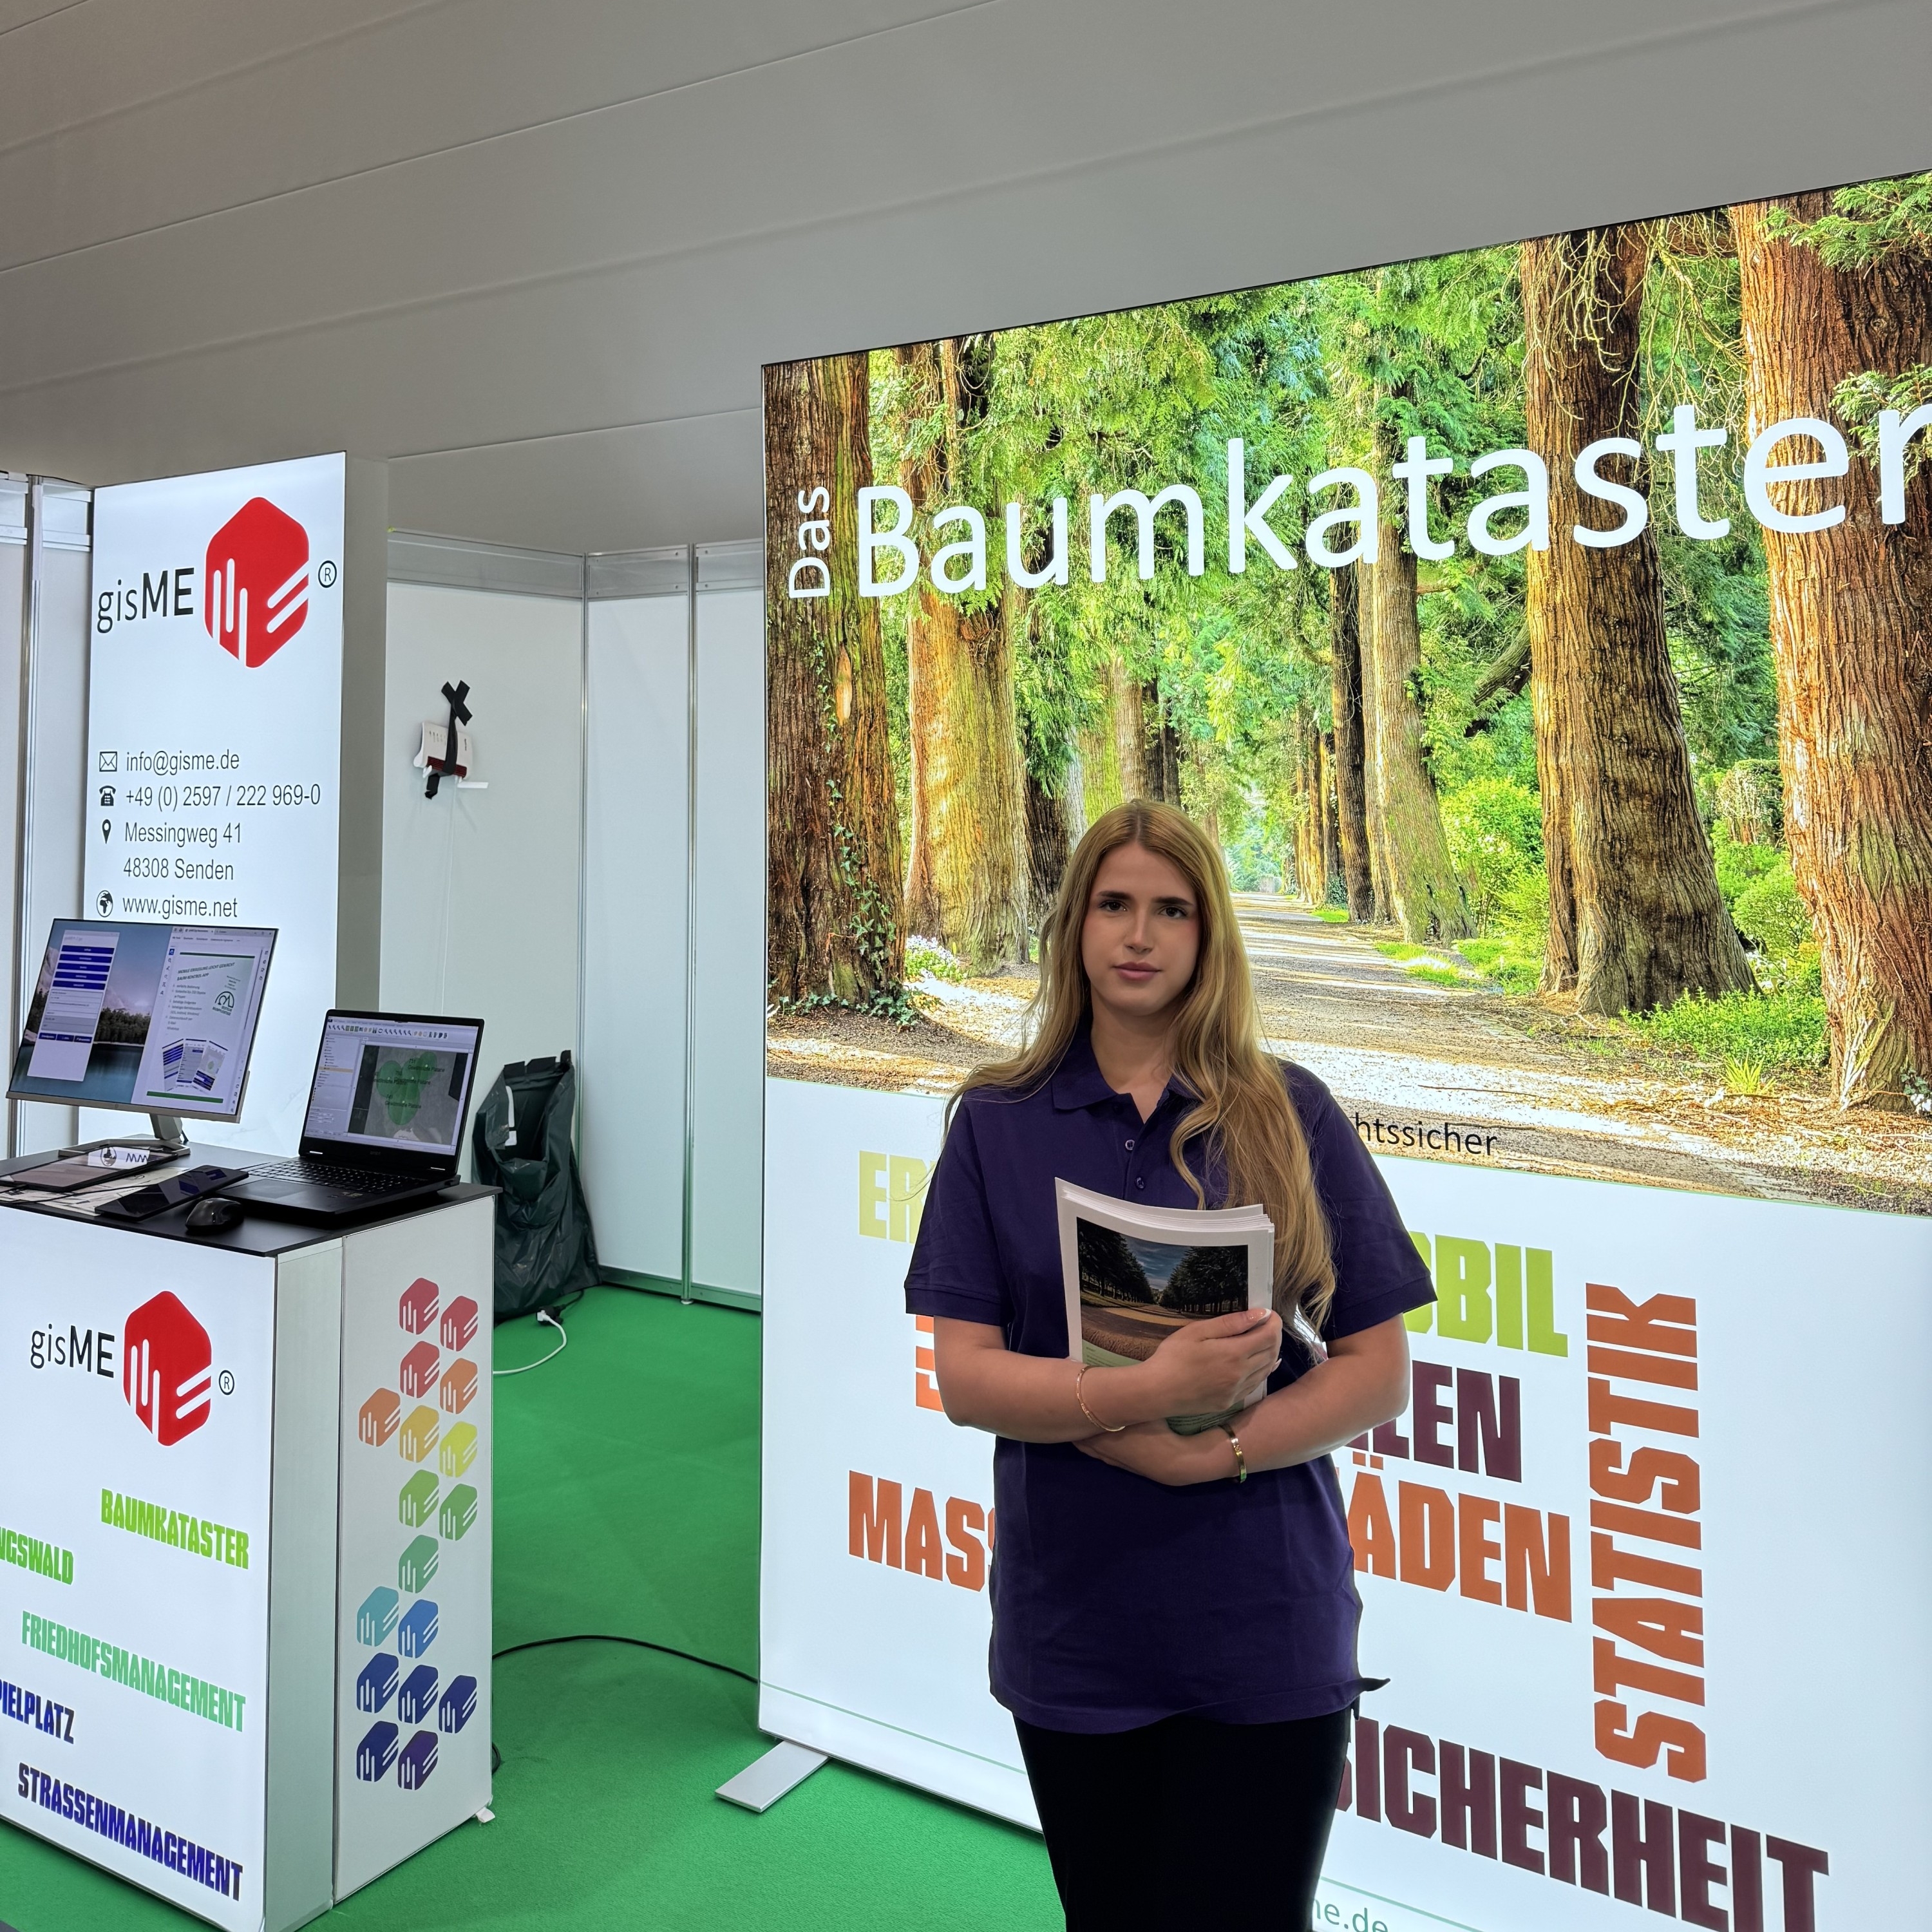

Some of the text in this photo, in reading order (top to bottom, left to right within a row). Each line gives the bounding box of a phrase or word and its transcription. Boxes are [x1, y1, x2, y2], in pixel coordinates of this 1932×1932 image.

[858, 403, 1932, 598] Baumkataster
[789, 486, 830, 598] Das
[97, 567, 194, 634] gisME
[126, 748, 240, 776] info@gisme.de
[126, 783, 321, 812] +49 (0) 2597 / 222 969-0
[123, 857, 234, 880] 48308 Senden
[125, 822, 242, 849] Messingweg 41
[122, 897, 238, 919] www.gisme.net
[1355, 1112, 1497, 1156] htssicher
[860, 1150, 936, 1244] ER
[31, 1324, 115, 1379] gisME
[1344, 1359, 1522, 1483] LEN
[101, 1488, 249, 1569] BAUMKATASTER
[849, 1470, 995, 1592] MAS
[1336, 1450, 1572, 1623] ÄDEN
[1586, 1282, 1707, 1783] STATISTIK
[22, 1610, 246, 1732] FRIEDHOFSMANAGEMENT
[0, 1679, 75, 1745] IELPLATZ
[18, 1762, 243, 1901] STRASSENMANAGEMENT
